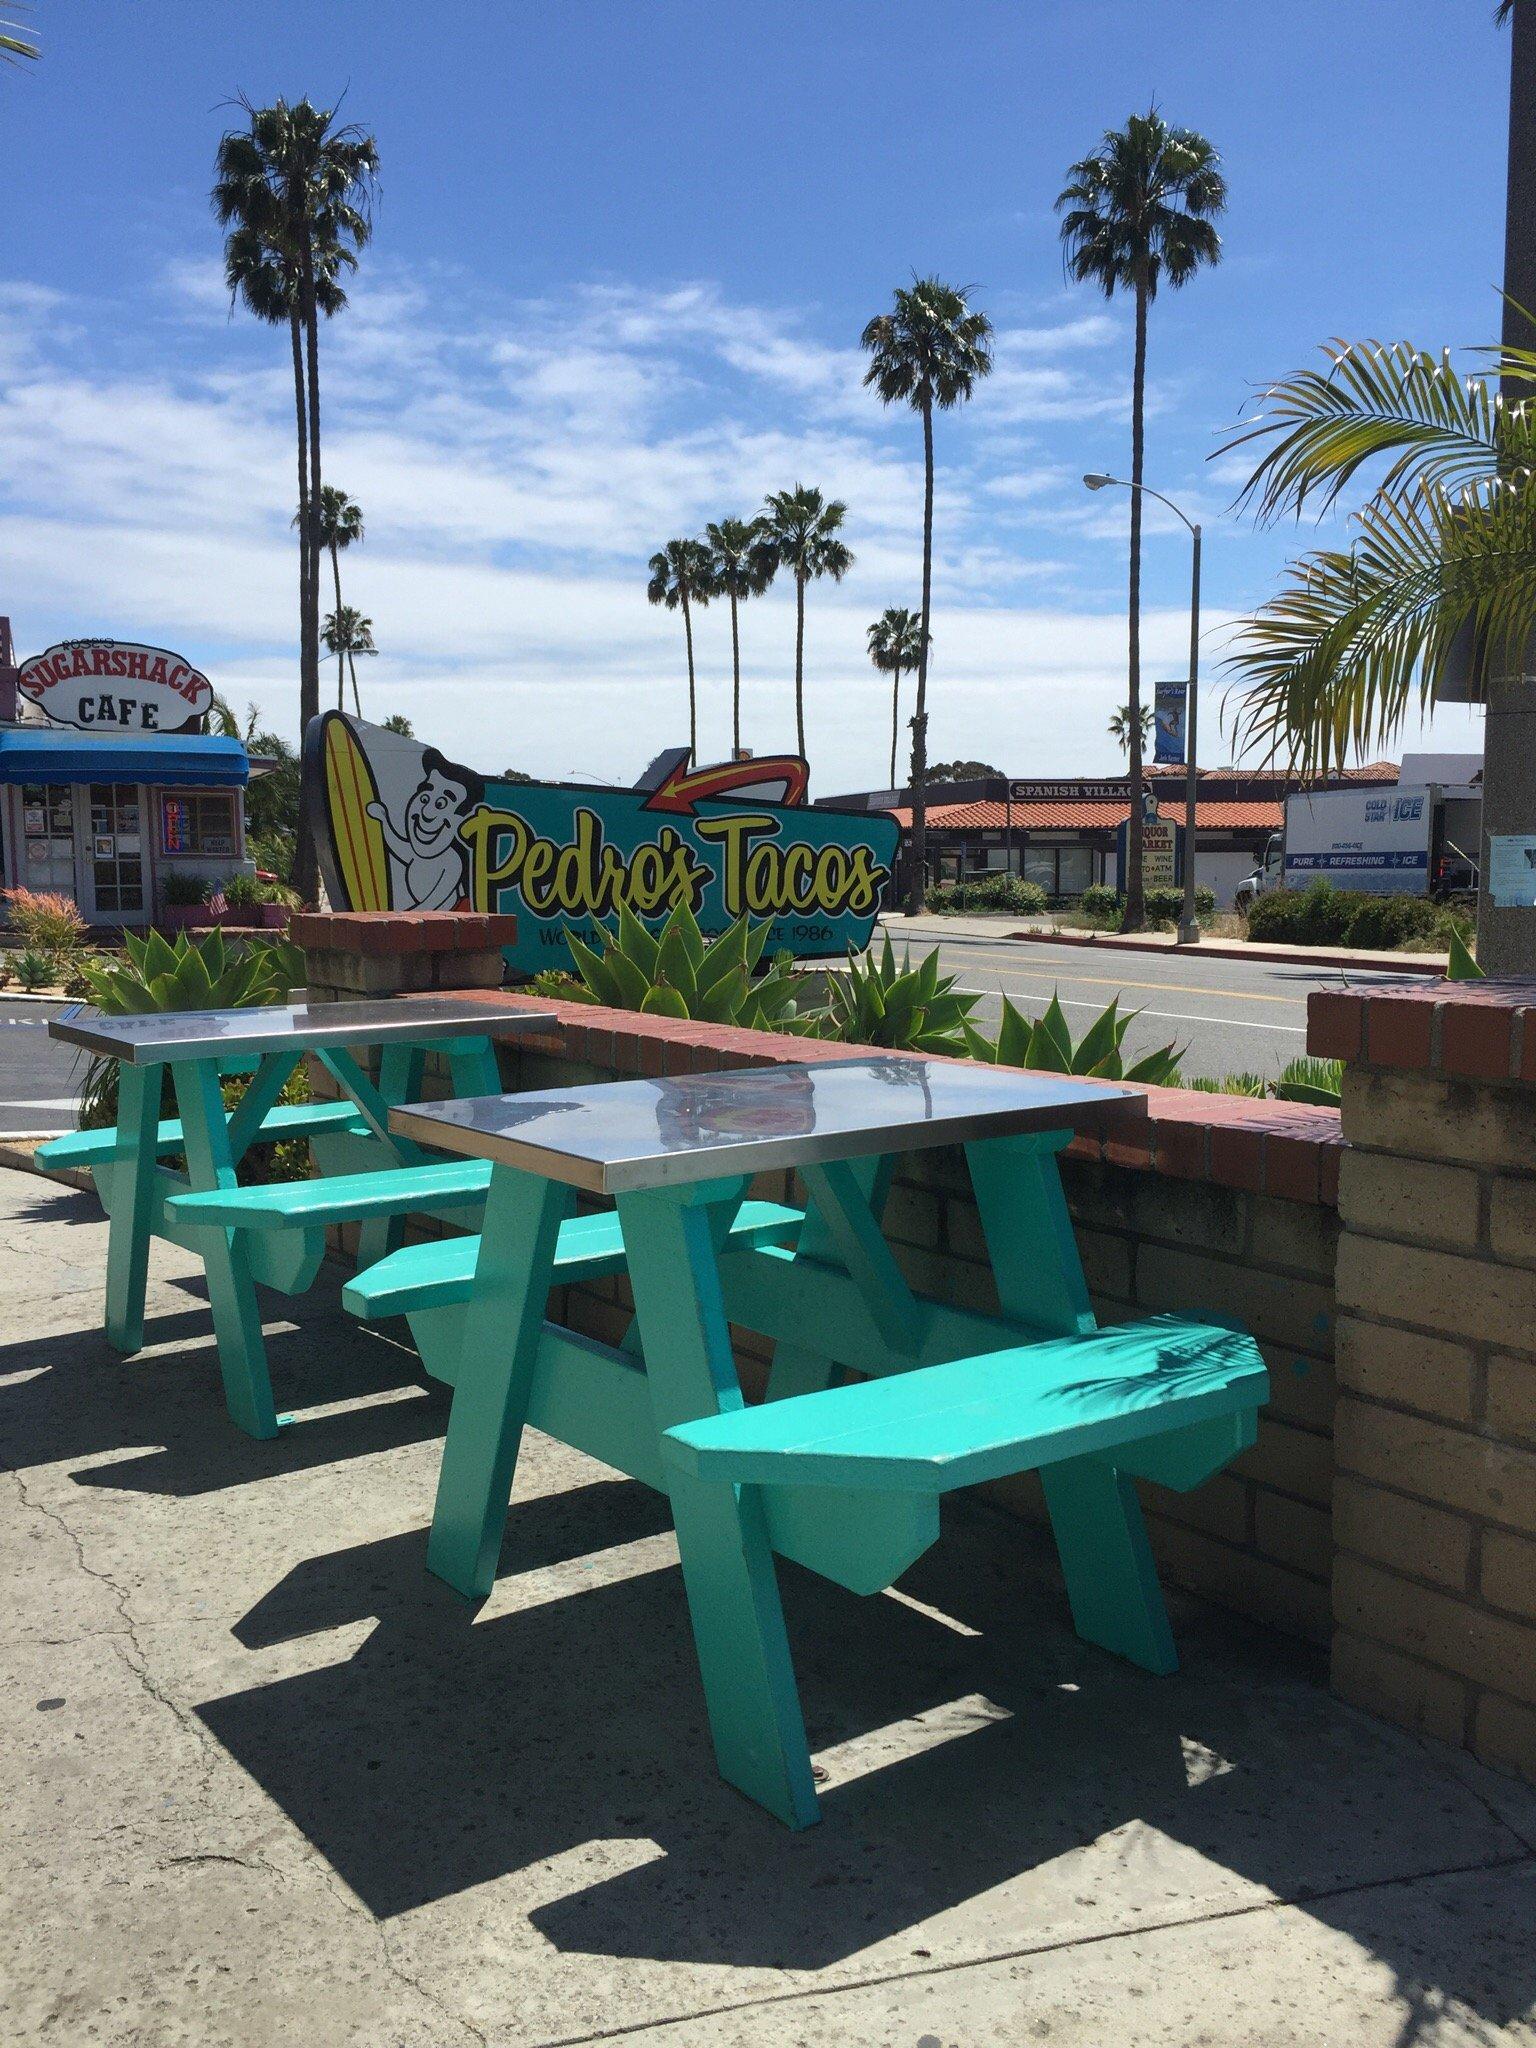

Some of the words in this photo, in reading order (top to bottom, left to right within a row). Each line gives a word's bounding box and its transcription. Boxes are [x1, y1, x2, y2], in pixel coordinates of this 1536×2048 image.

[20, 649, 210, 705] SUGARSHACK
[78, 694, 159, 729] CAFE
[1015, 786, 1080, 796] SPANISH
[1083, 786, 1144, 797] VILLA
[1393, 796, 1424, 821] ICE
[1141, 826, 1169, 839] IQUOR
[1142, 839, 1173, 849] ARKET
[458, 805, 714, 920] Pedro's
[697, 814, 889, 920] Tacos
[1154, 855, 1173, 863] WINE
[1293, 857, 1314, 866] PURE
[1329, 856, 1385, 865] REFRESHING
[1402, 855, 1418, 865] ICE
[792, 924, 834, 941] 1986
